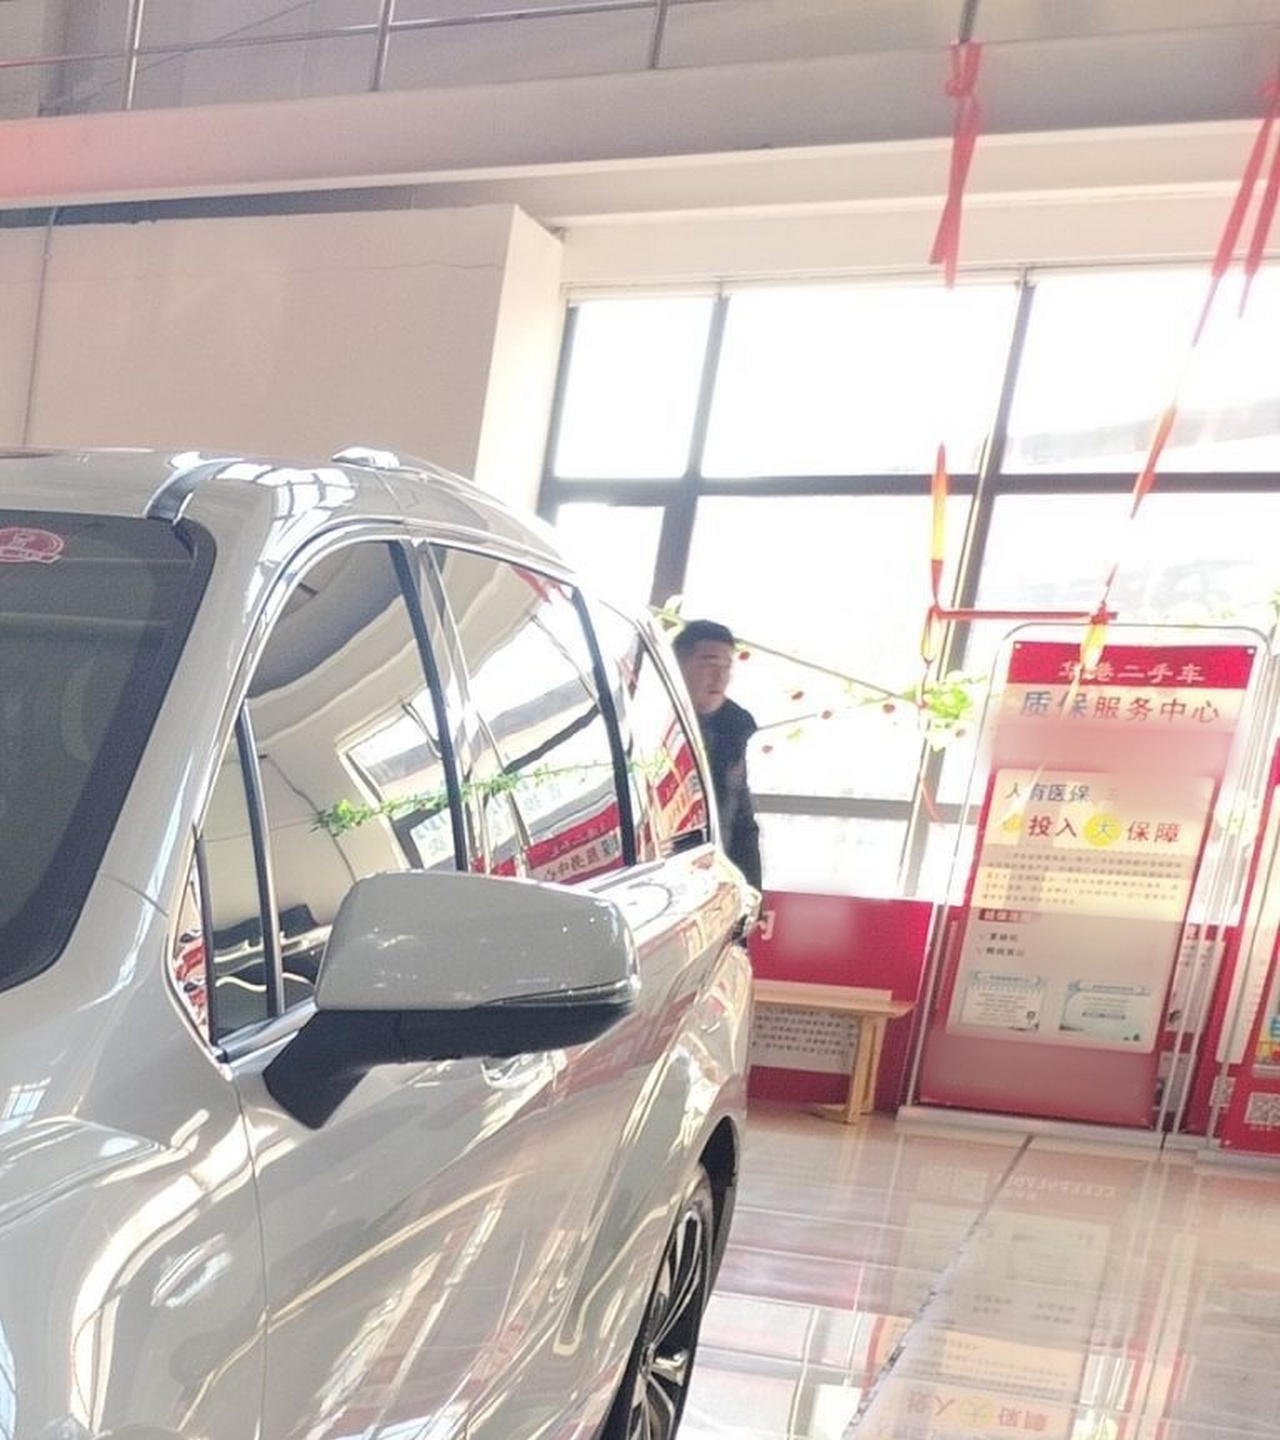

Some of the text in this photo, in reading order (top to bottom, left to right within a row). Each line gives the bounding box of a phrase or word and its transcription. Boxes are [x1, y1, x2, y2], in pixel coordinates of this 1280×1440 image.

[1002, 813, 1181, 844] 投入大保障
